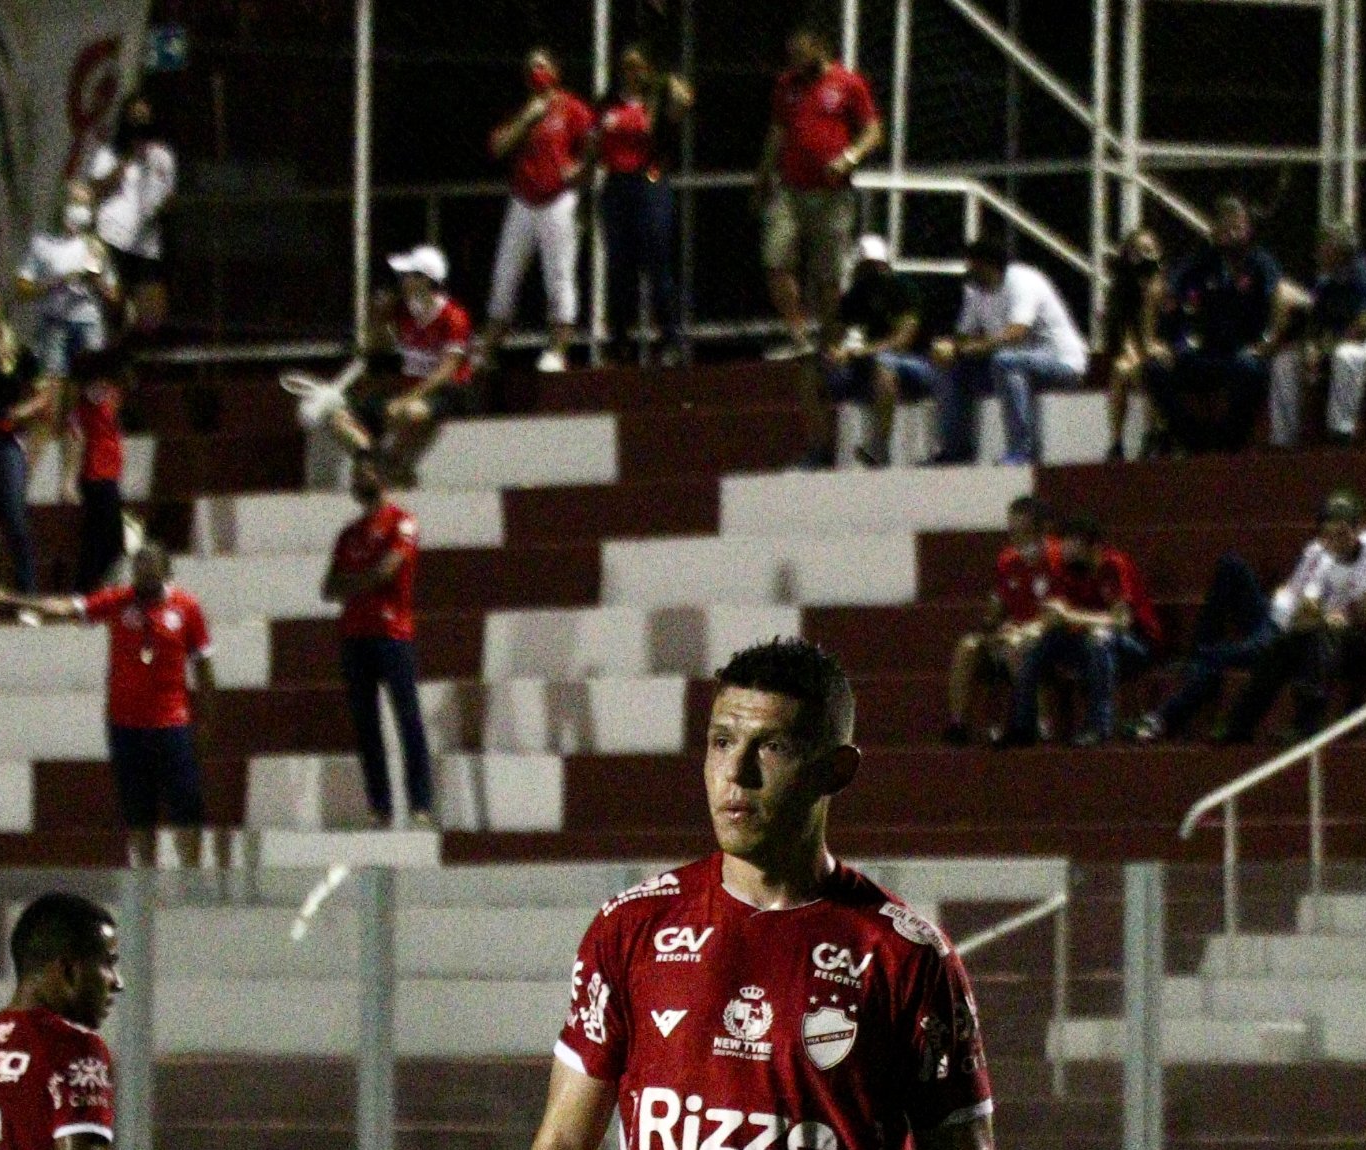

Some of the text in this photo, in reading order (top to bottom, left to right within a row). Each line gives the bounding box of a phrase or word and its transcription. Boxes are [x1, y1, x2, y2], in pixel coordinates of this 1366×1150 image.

[655, 952, 702, 963] RESORTS
[713, 1035, 742, 1053] NEW
[743, 1040, 774, 1056] TYRE
